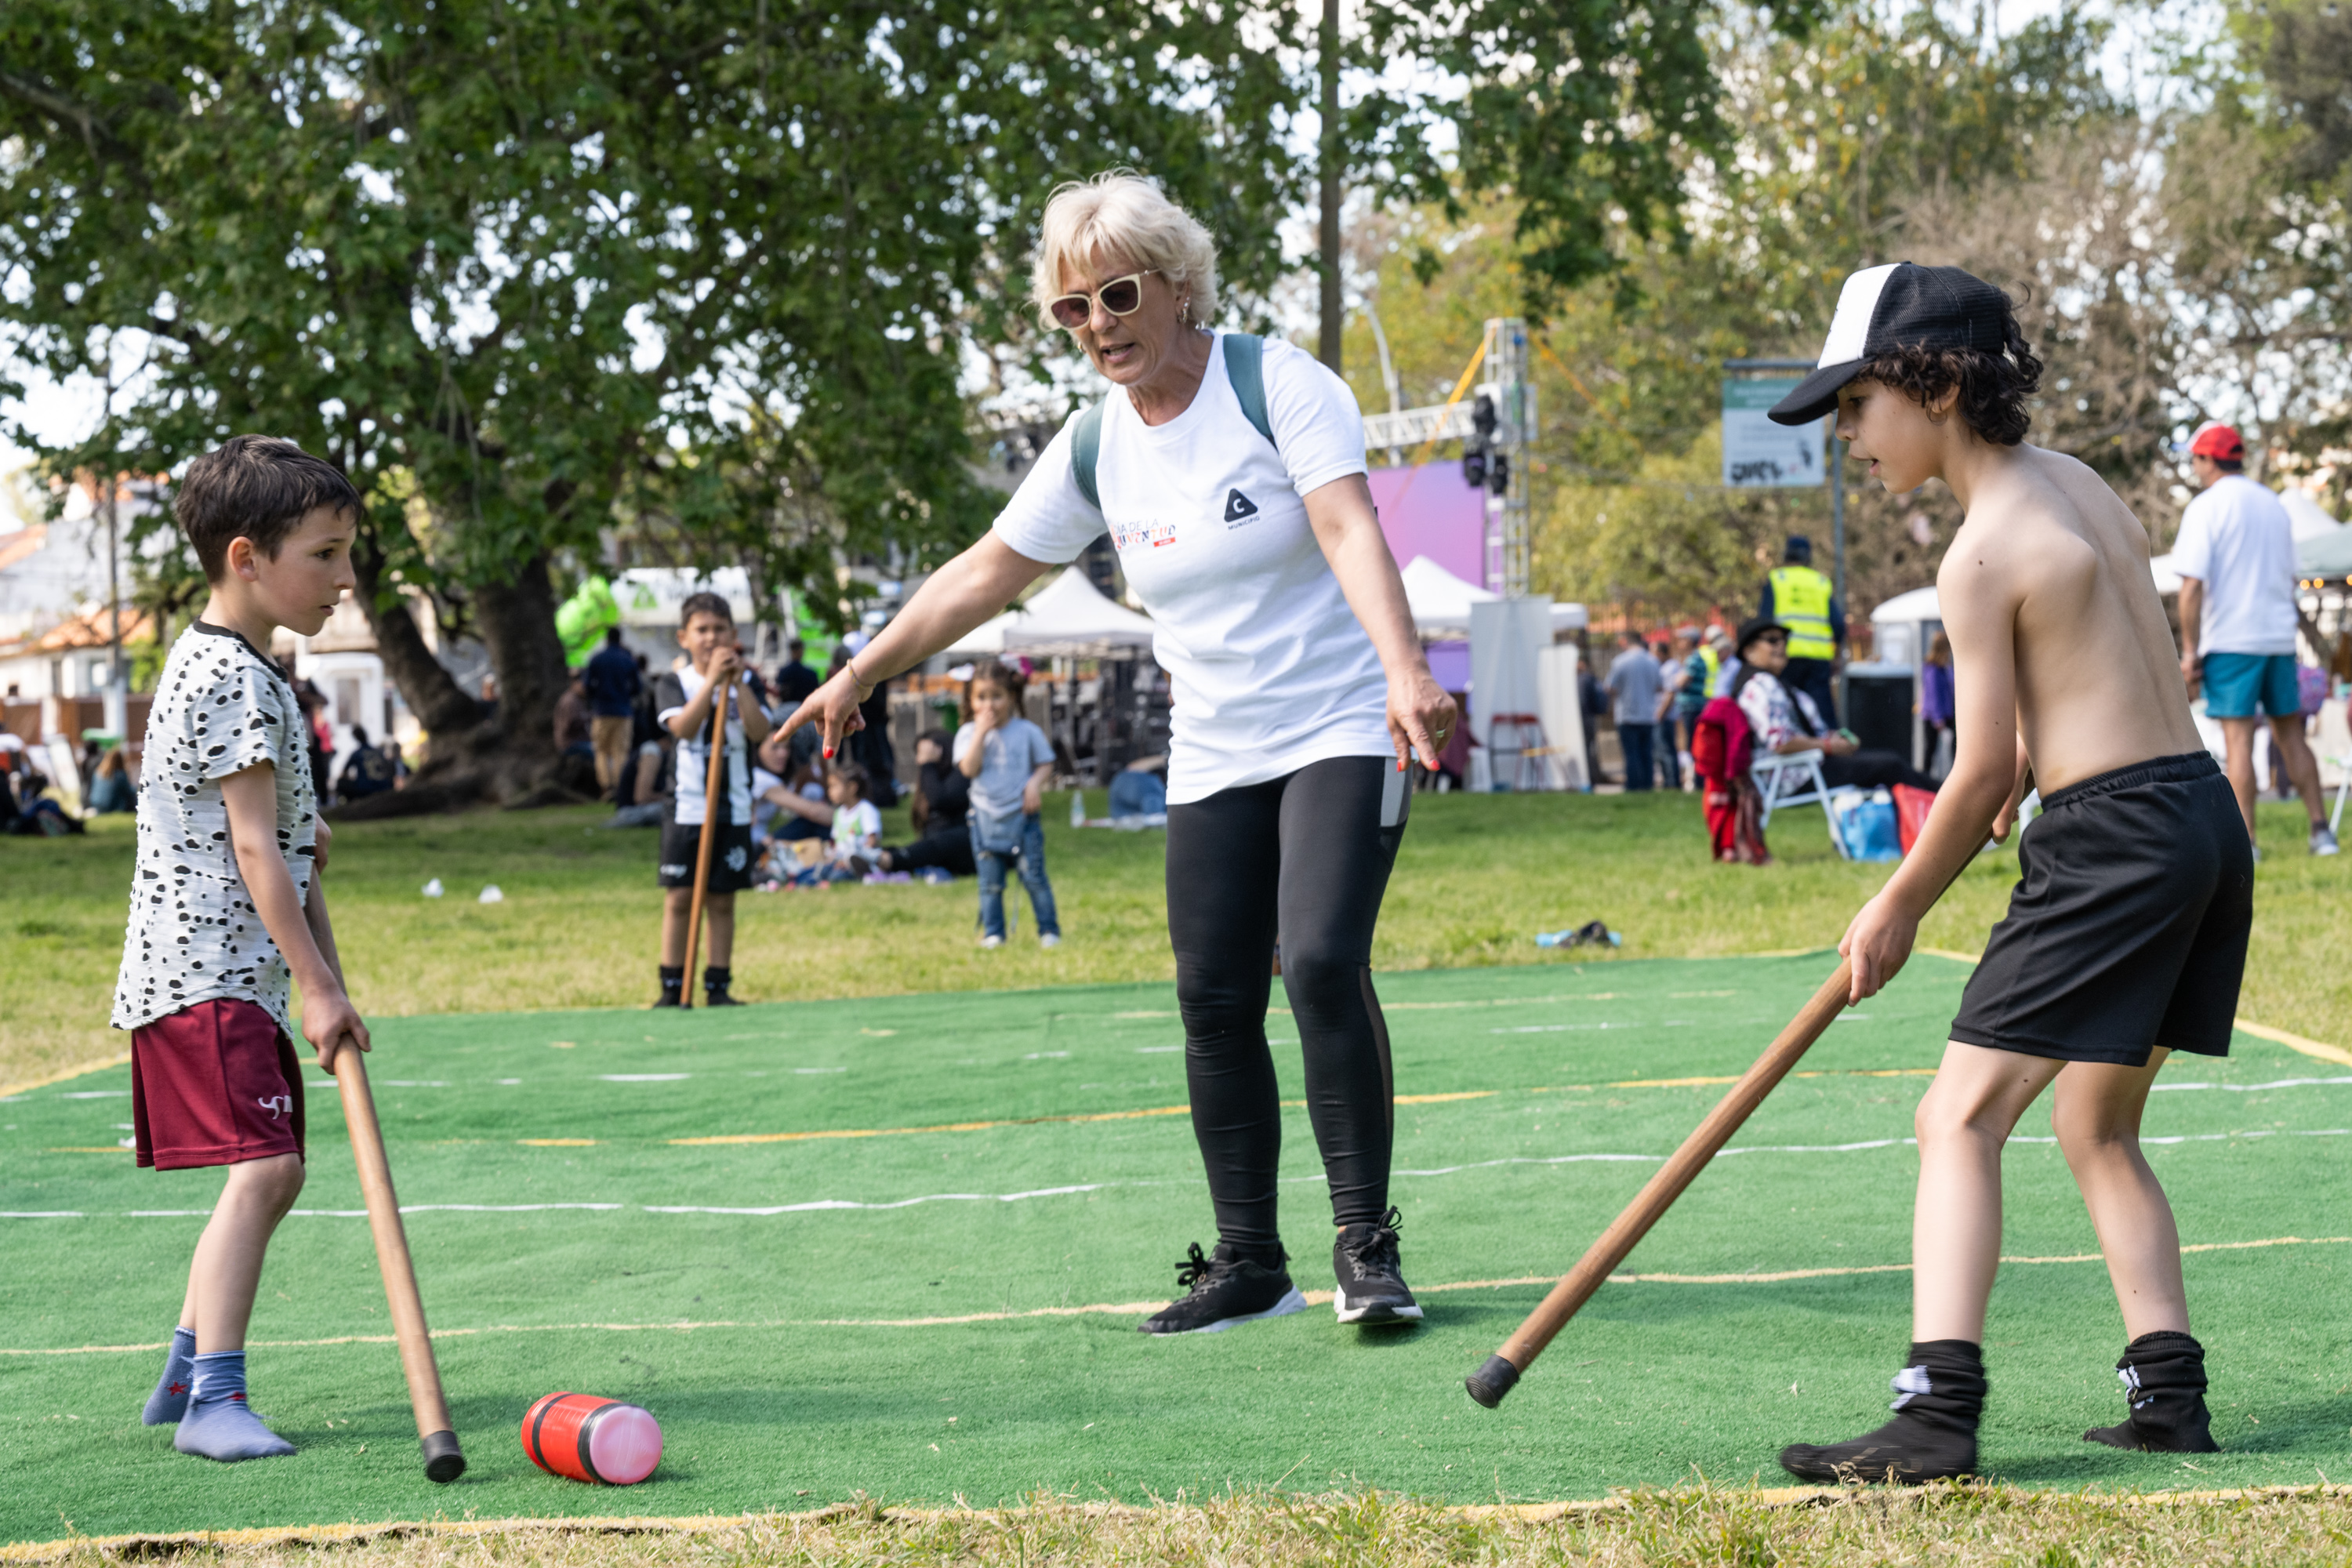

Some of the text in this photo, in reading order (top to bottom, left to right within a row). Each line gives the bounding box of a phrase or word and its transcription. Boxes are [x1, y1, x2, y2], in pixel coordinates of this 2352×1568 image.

[1233, 498, 1245, 514] C
[1129, 521, 1142, 533] DE
[1145, 518, 1159, 529] LA
[1228, 515, 1260, 530] MUNICIPIO
[1116, 524, 1176, 549] JUVENTUD
